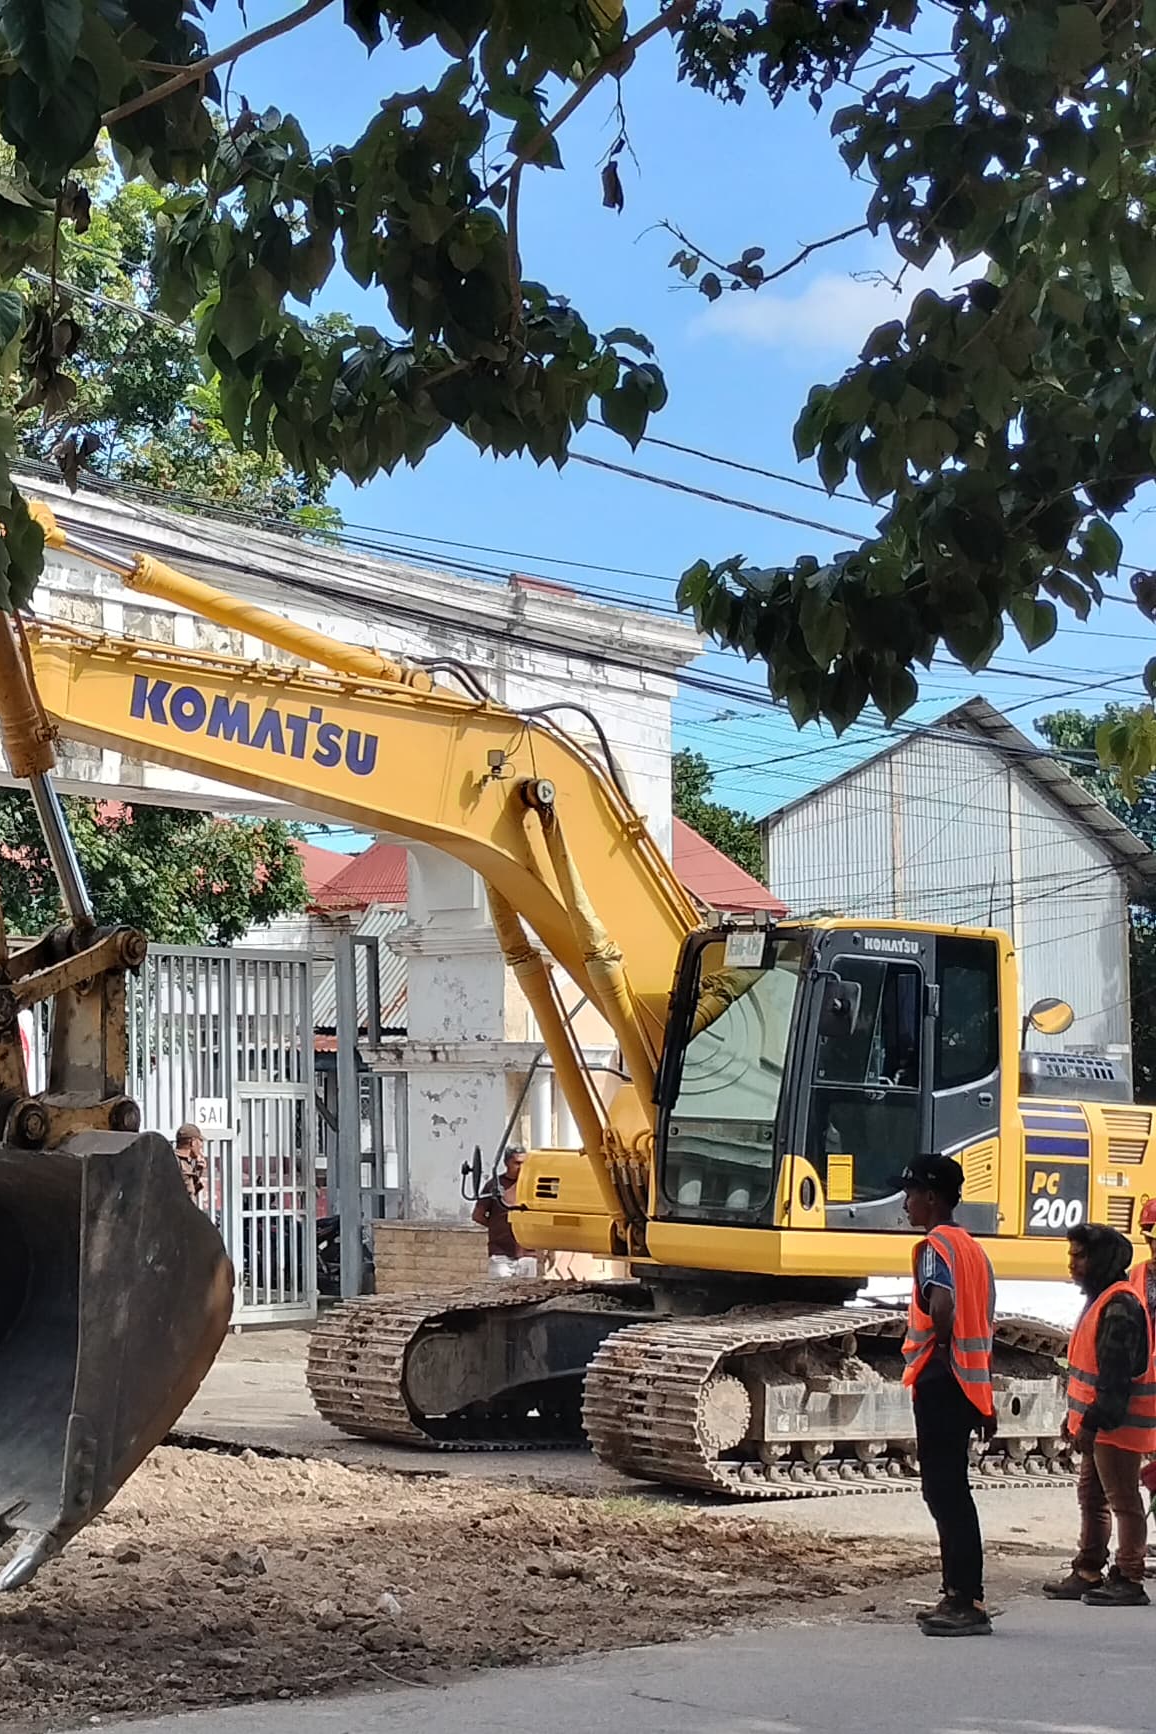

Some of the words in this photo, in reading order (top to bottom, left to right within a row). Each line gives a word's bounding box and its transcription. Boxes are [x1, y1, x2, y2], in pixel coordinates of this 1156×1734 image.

[130, 674, 379, 776] KOMATSU
[864, 937, 919, 954] KOMATSU
[199, 1106, 223, 1124] SAI
[1031, 1170, 1061, 1195] PC
[1029, 1197, 1084, 1230] 200
